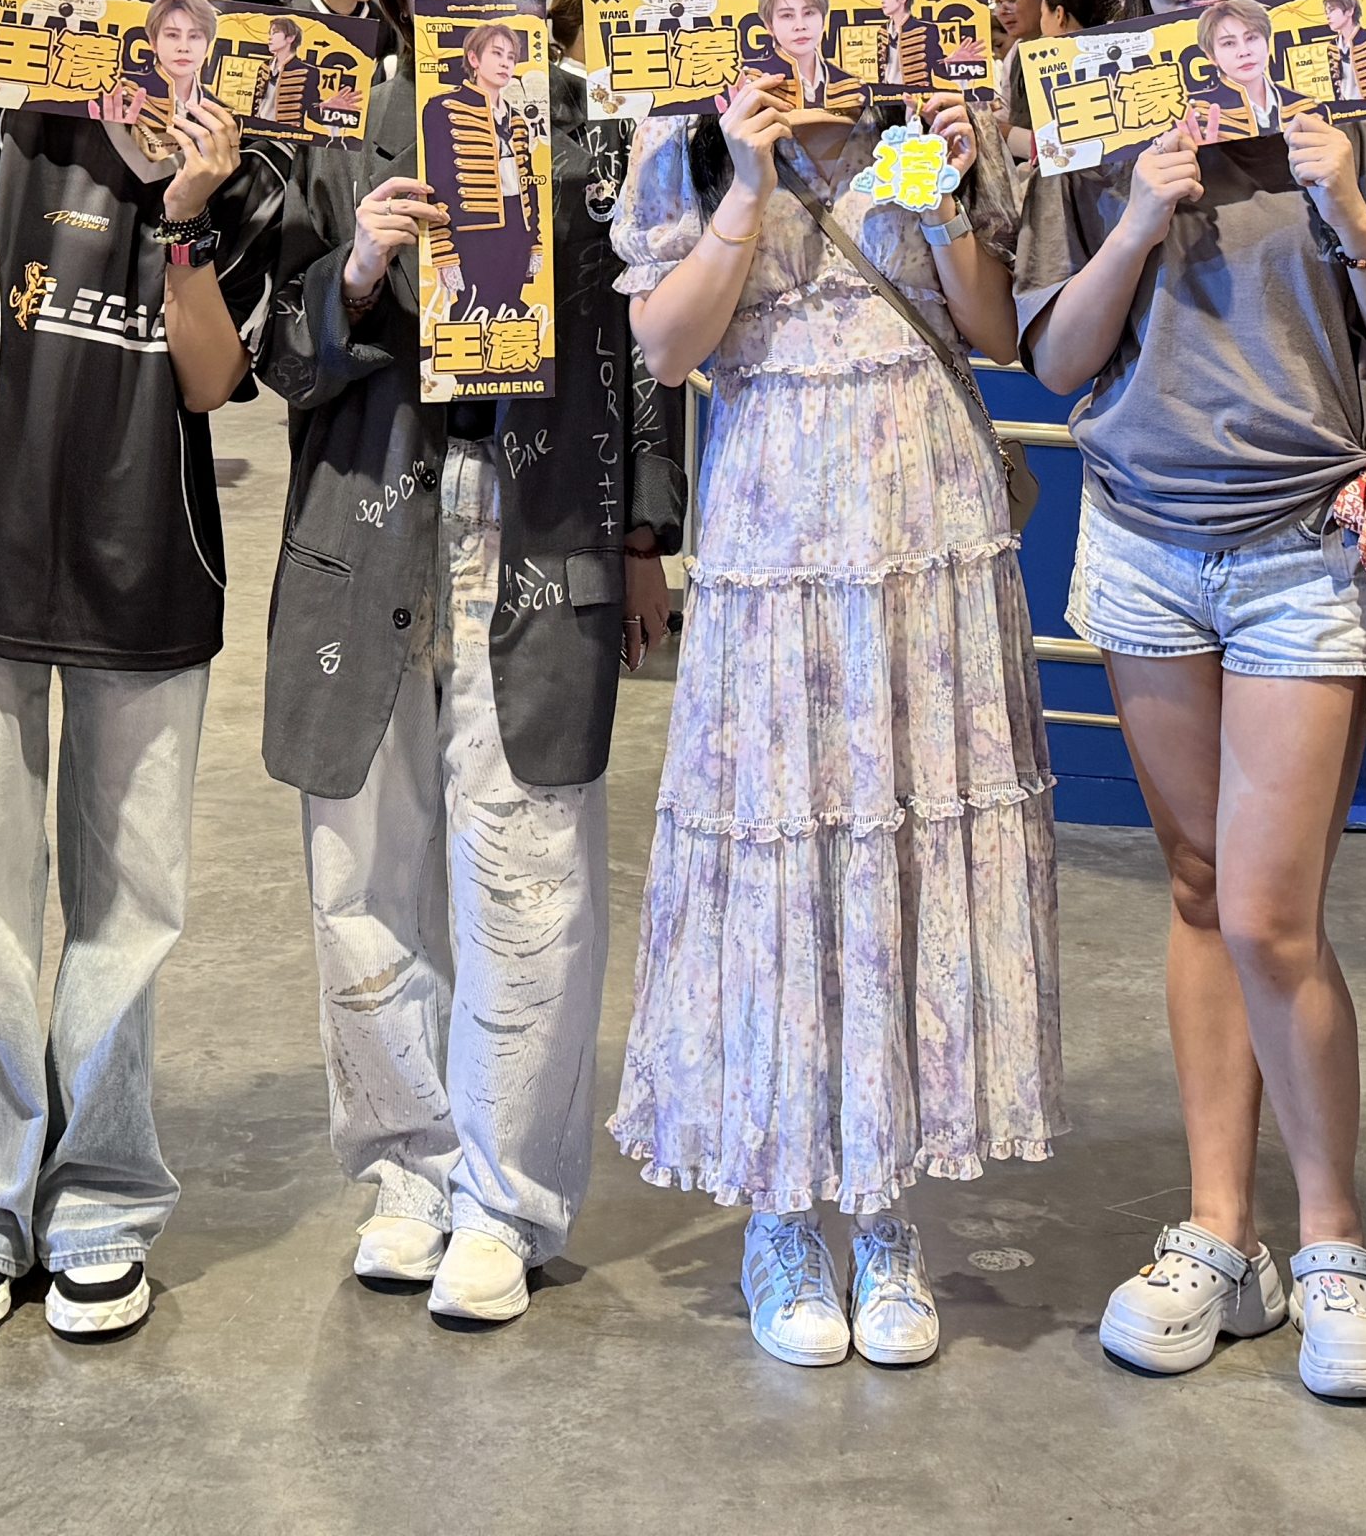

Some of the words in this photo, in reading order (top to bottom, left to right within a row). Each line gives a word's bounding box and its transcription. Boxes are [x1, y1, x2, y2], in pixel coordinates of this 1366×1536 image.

[599, 10, 629, 20] WANG
[426, 23, 454, 34] KING
[610, 28, 741, 90] 王濛
[420, 63, 449, 73] MENG
[1038, 62, 1068, 75] WANG
[1052, 64, 1189, 143] 王濛
[520, 174, 546, 185] 0709
[434, 318, 542, 372] 王濛
